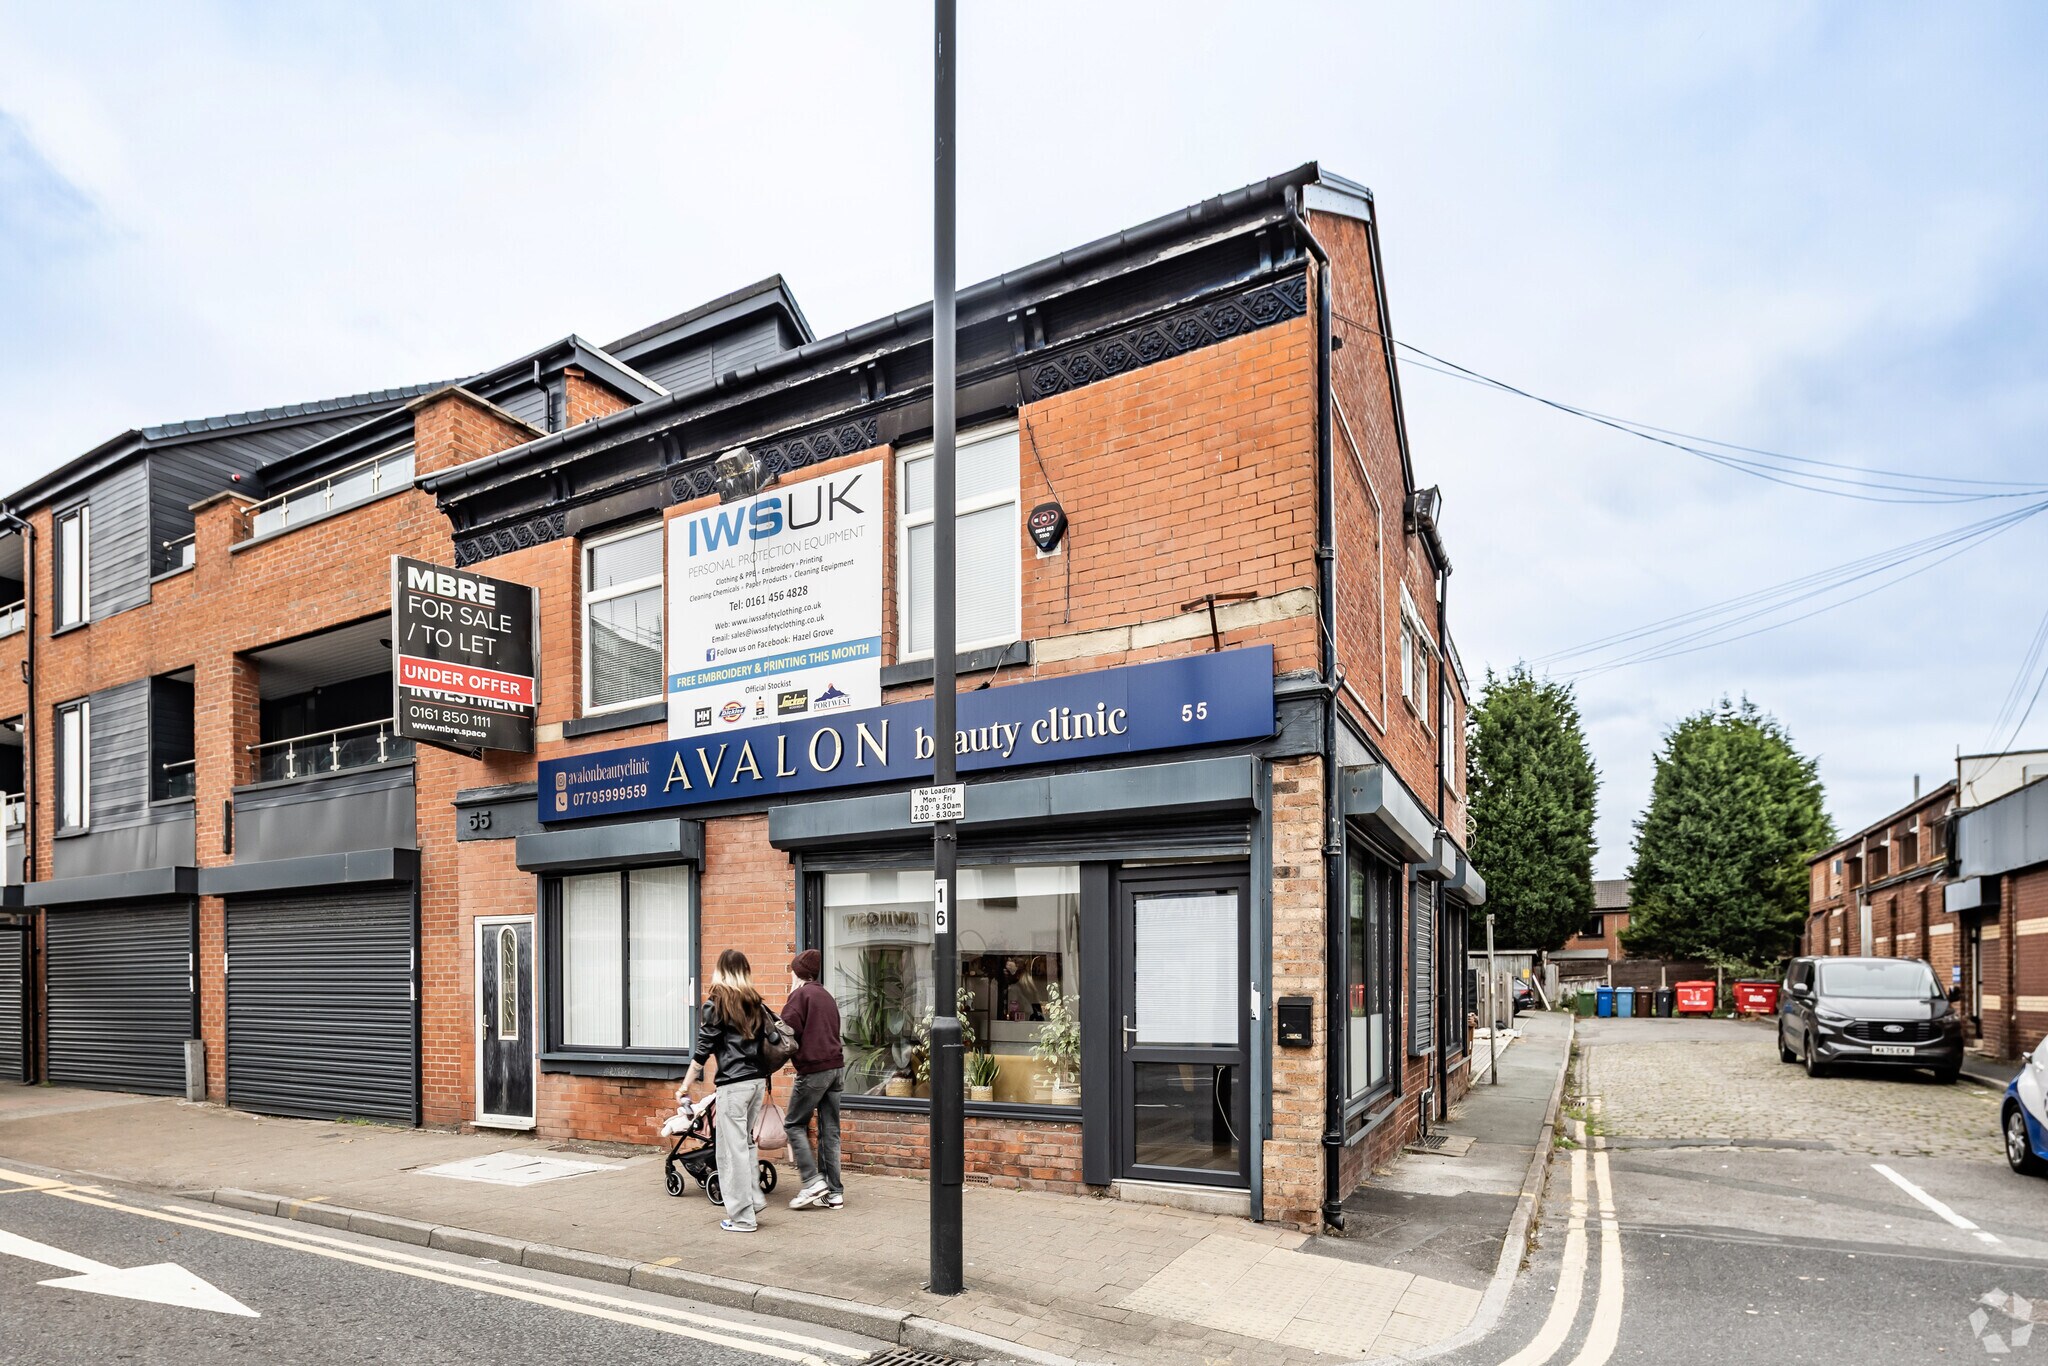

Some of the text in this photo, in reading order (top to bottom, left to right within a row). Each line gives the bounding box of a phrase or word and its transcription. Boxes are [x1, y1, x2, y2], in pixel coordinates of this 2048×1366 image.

[689, 525, 865, 578] PERSONAL PROTECTION EQUIPMENT
[690, 559, 854, 602] Cleaning Chemicals Paper Products Cleaning Equipment
[716, 575, 738, 586] Clothing
[746, 570, 756, 578] PPE
[762, 562, 795, 575] Embroidery
[800, 556, 822, 566] Printing
[407, 566, 496, 606] MBRE
[730, 586, 808, 611] Tel: 0161 456 4828
[408, 595, 512, 634] FOR SALE
[714, 602, 822, 630] Web: www.iwssafetyclothing.co.uk
[407, 622, 496, 656] / TO LET
[712, 614, 824, 644] Email: sales@iwssafetyclothing.co.uk
[716, 645, 738, 657] Follow
[758, 636, 790, 648] Facebook:
[792, 630, 811, 642] Hazel
[812, 628, 834, 638] Grove
[676, 643, 870, 688] FREE EMBROIDERY & PRINTING THIS MONTH
[404, 664, 520, 696] UNDER OFFER
[744, 680, 792, 694] Official Stockist
[410, 706, 491, 728] 0161 850 1111
[814, 698, 850, 710] PORTWEST
[1182, 702, 1208, 722] 55
[412, 722, 486, 738] www.mbre.space
[663, 702, 1128, 793] AVALON bauty clinic
[568, 758, 650, 785] avalonbeautyclinic
[573, 784, 647, 806] 07795999559
[930, 787, 956, 795] Loading
[469, 811, 491, 830] 55
